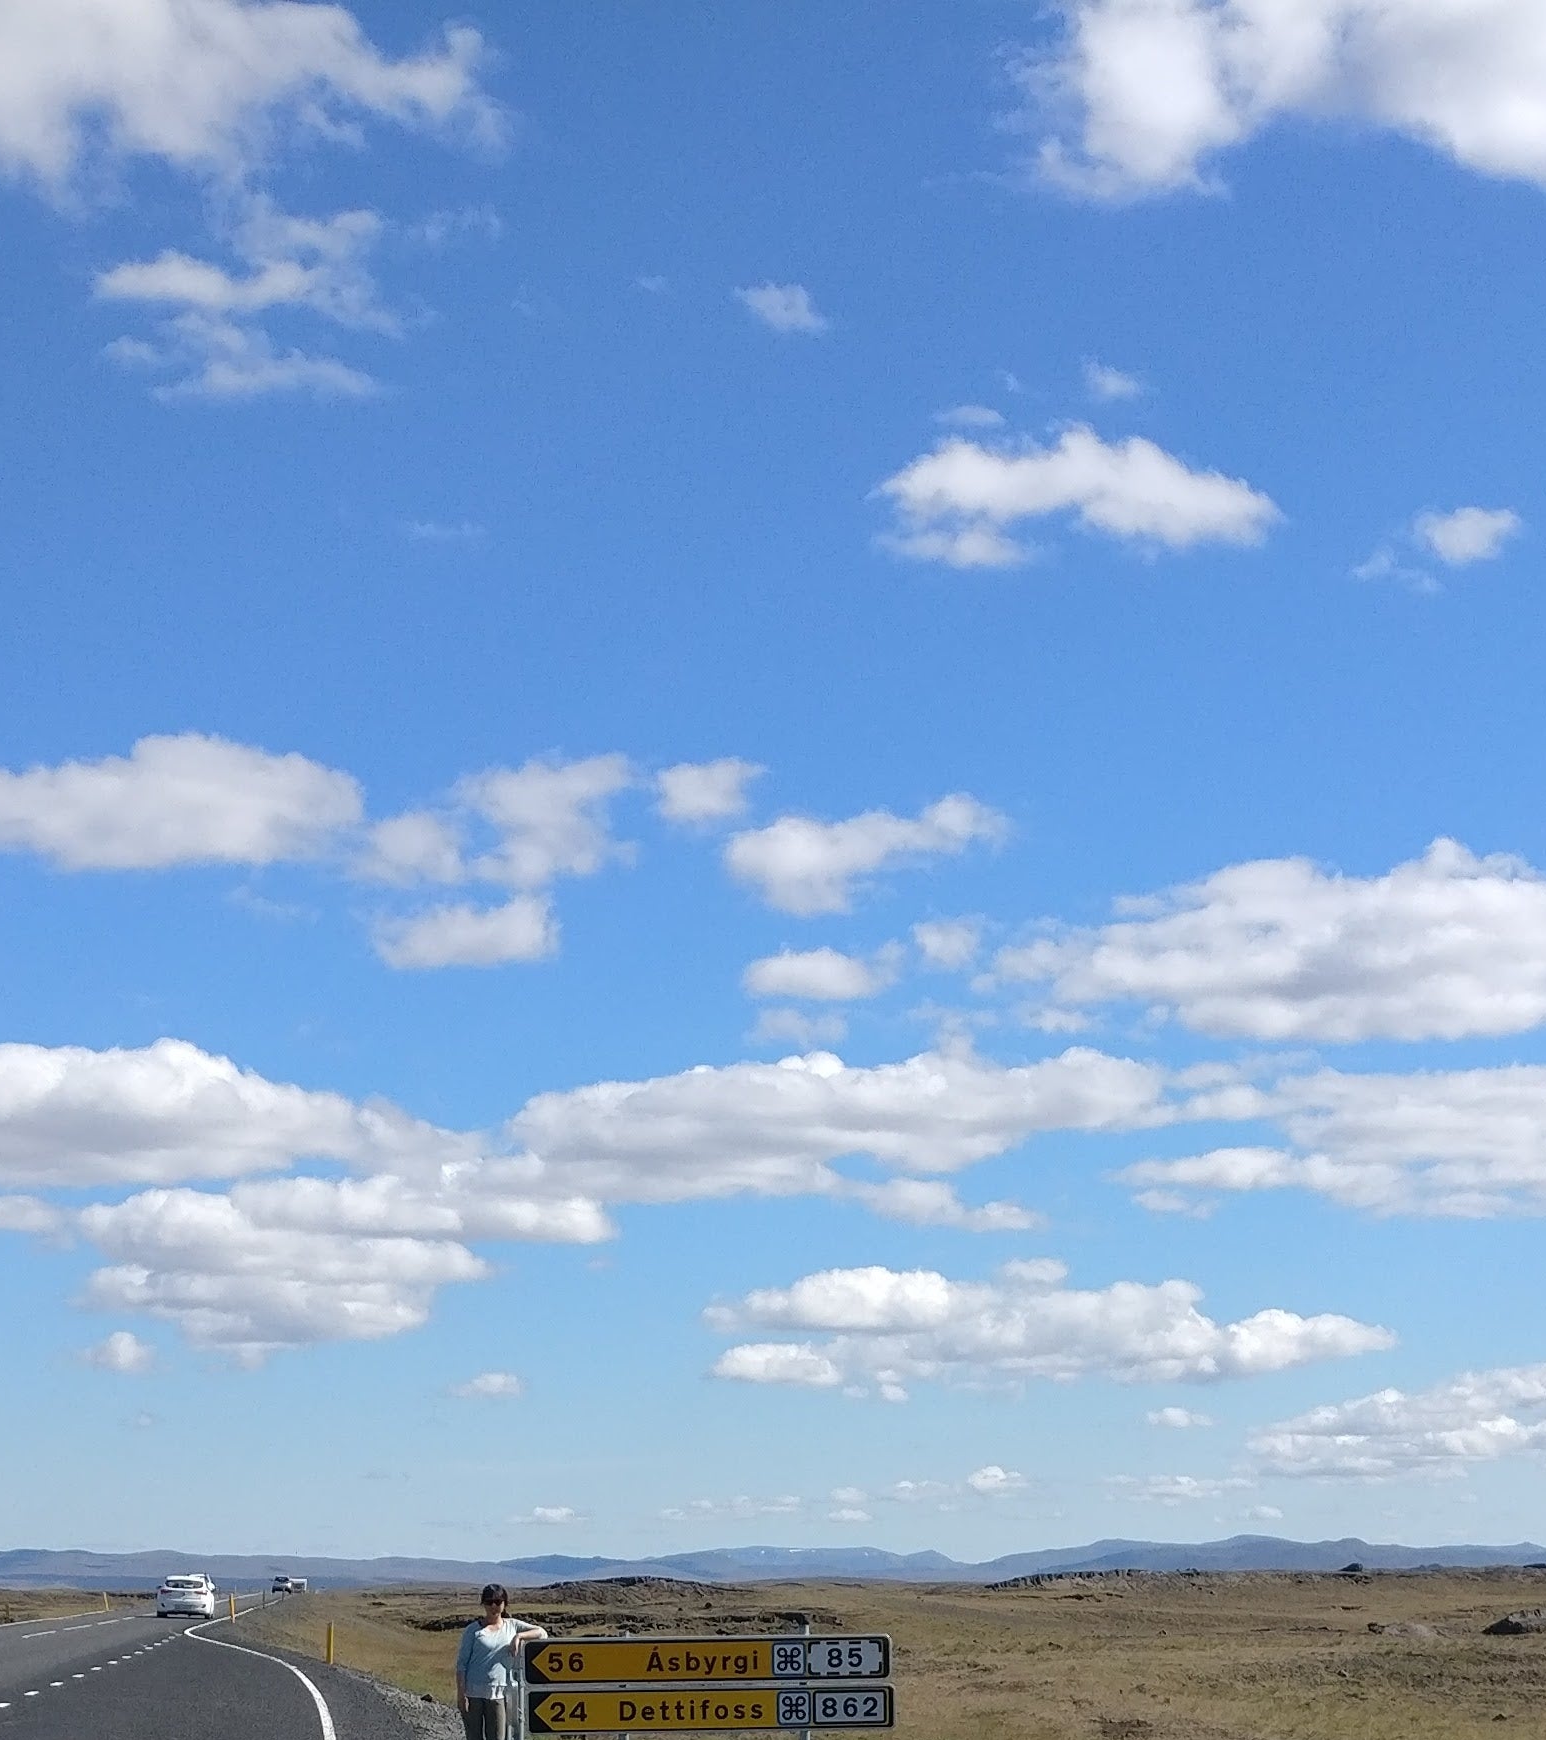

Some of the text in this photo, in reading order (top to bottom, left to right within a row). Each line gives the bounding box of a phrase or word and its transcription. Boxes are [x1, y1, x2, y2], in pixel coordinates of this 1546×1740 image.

[547, 1646, 864, 1674] 56 Ásbyrgi 85
[549, 1696, 879, 1722] 24 Dettifoss 862
